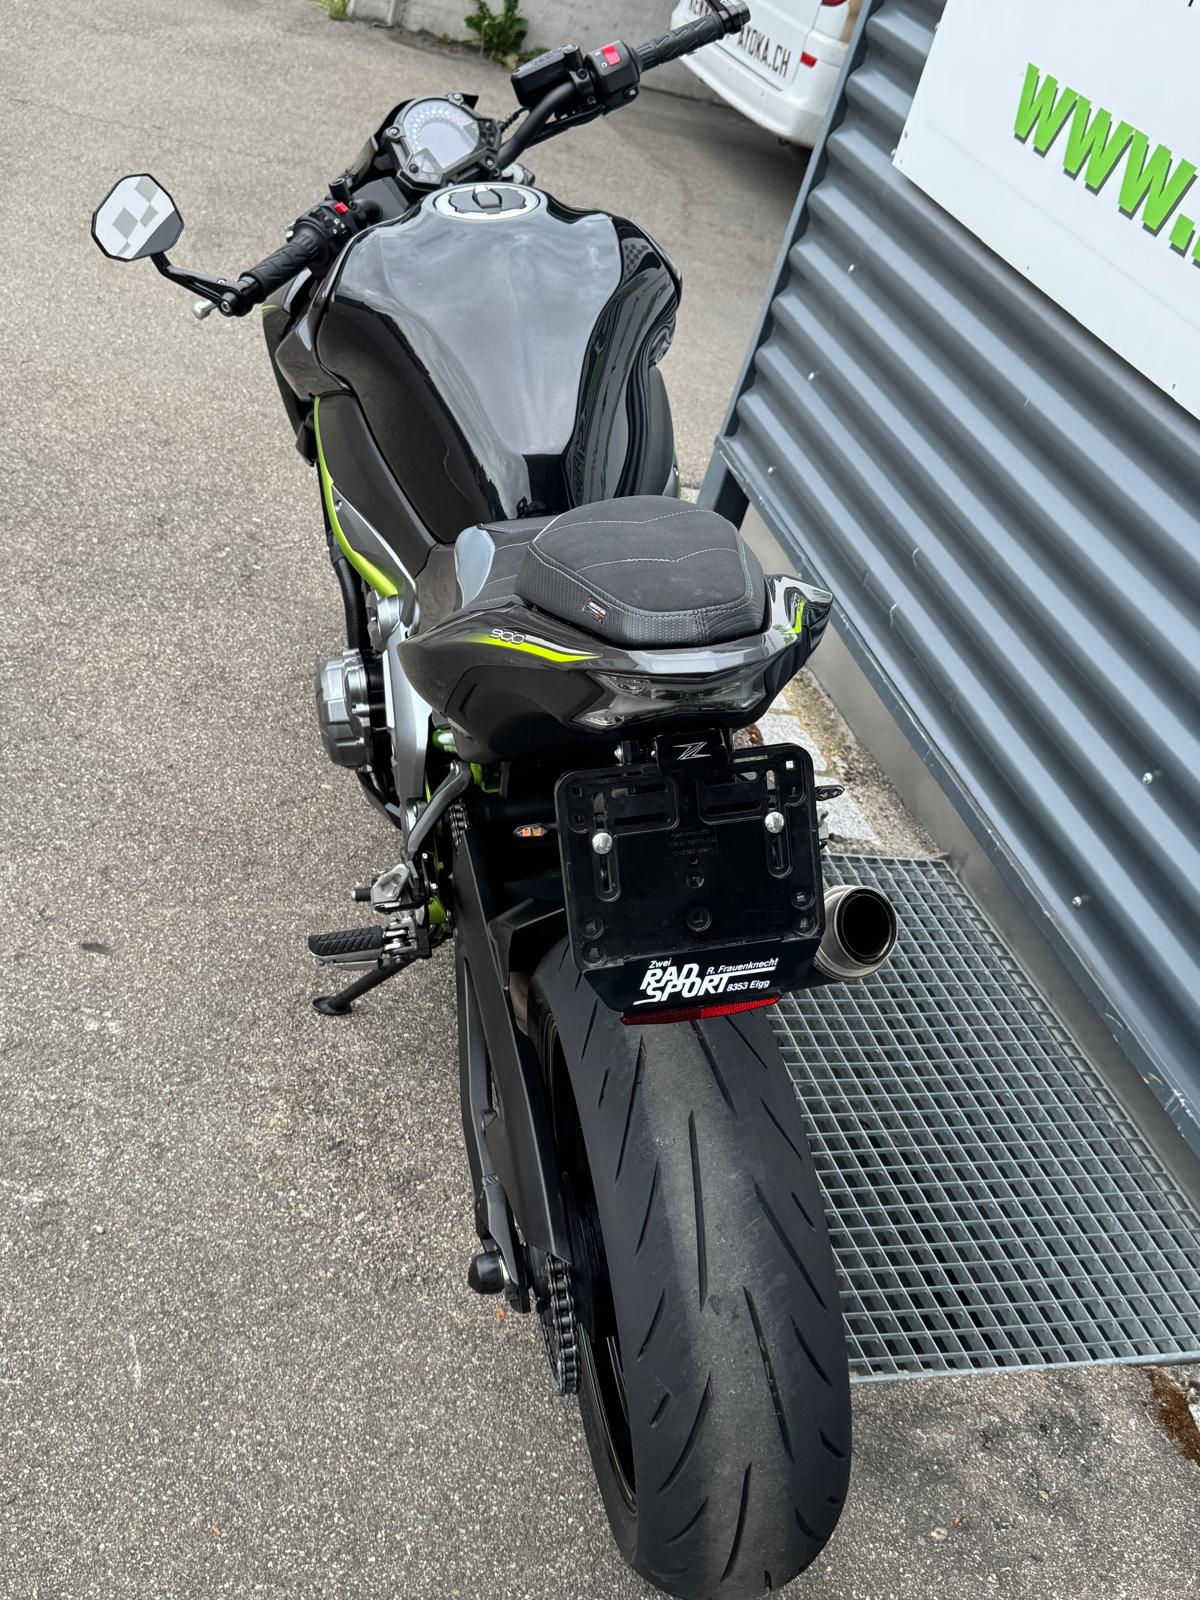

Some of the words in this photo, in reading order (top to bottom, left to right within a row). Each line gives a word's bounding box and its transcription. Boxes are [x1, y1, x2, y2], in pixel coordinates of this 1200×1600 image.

[489, 627, 527, 645] 900
[649, 957, 672, 969] Zwei
[706, 966, 716, 975] R.
[717, 957, 779, 974] Frauenknecht
[639, 963, 700, 991] RAD
[726, 981, 748, 992] 8353
[749, 979, 770, 991] Elgg
[633, 974, 731, 1006] SPORT
